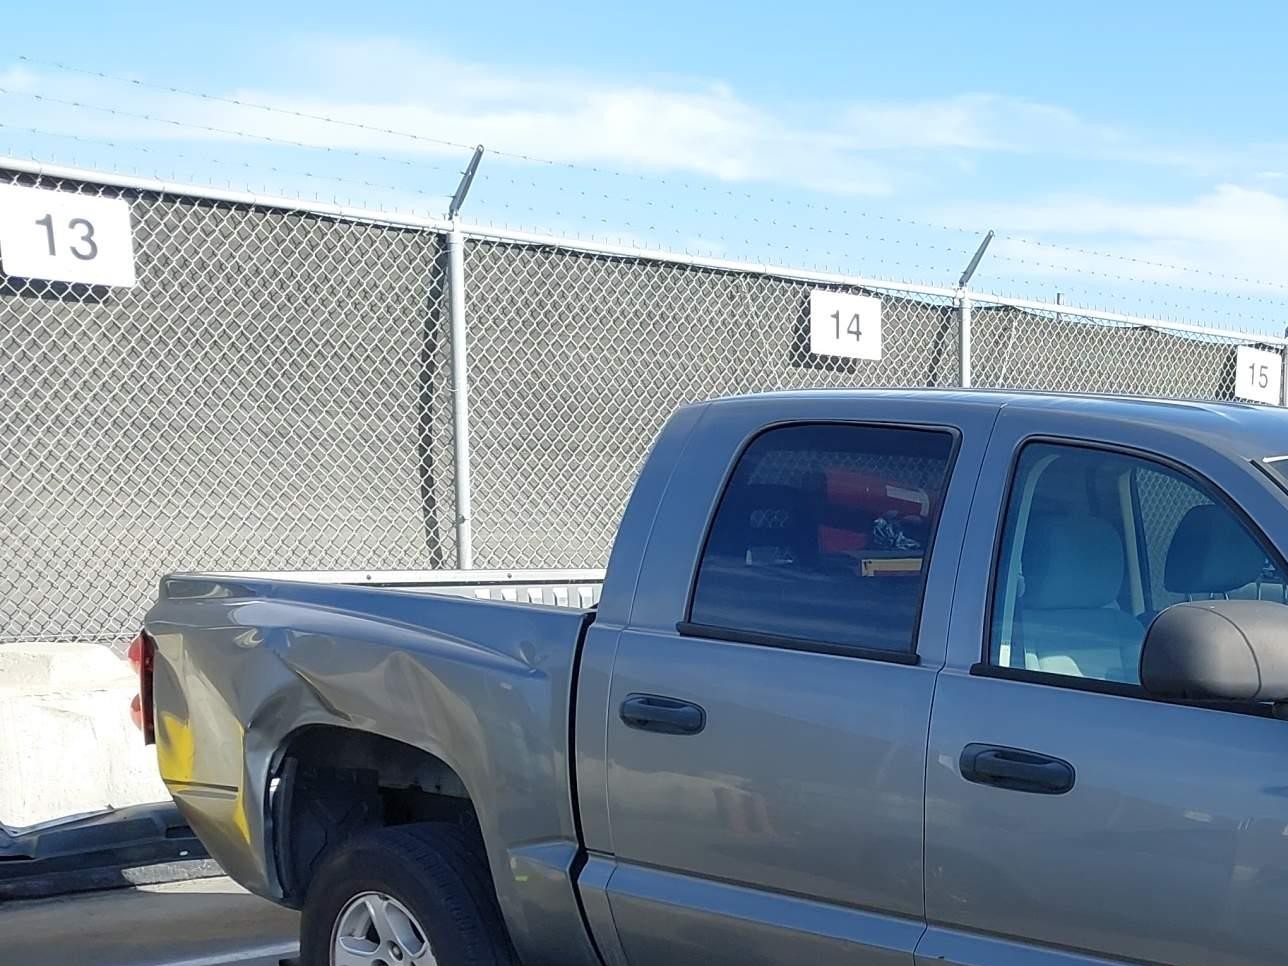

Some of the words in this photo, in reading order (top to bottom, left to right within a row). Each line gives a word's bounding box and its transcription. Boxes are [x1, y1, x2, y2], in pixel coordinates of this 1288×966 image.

[35, 213, 98, 260] 13
[830, 310, 862, 342] 14
[1249, 363, 1269, 389] 15
